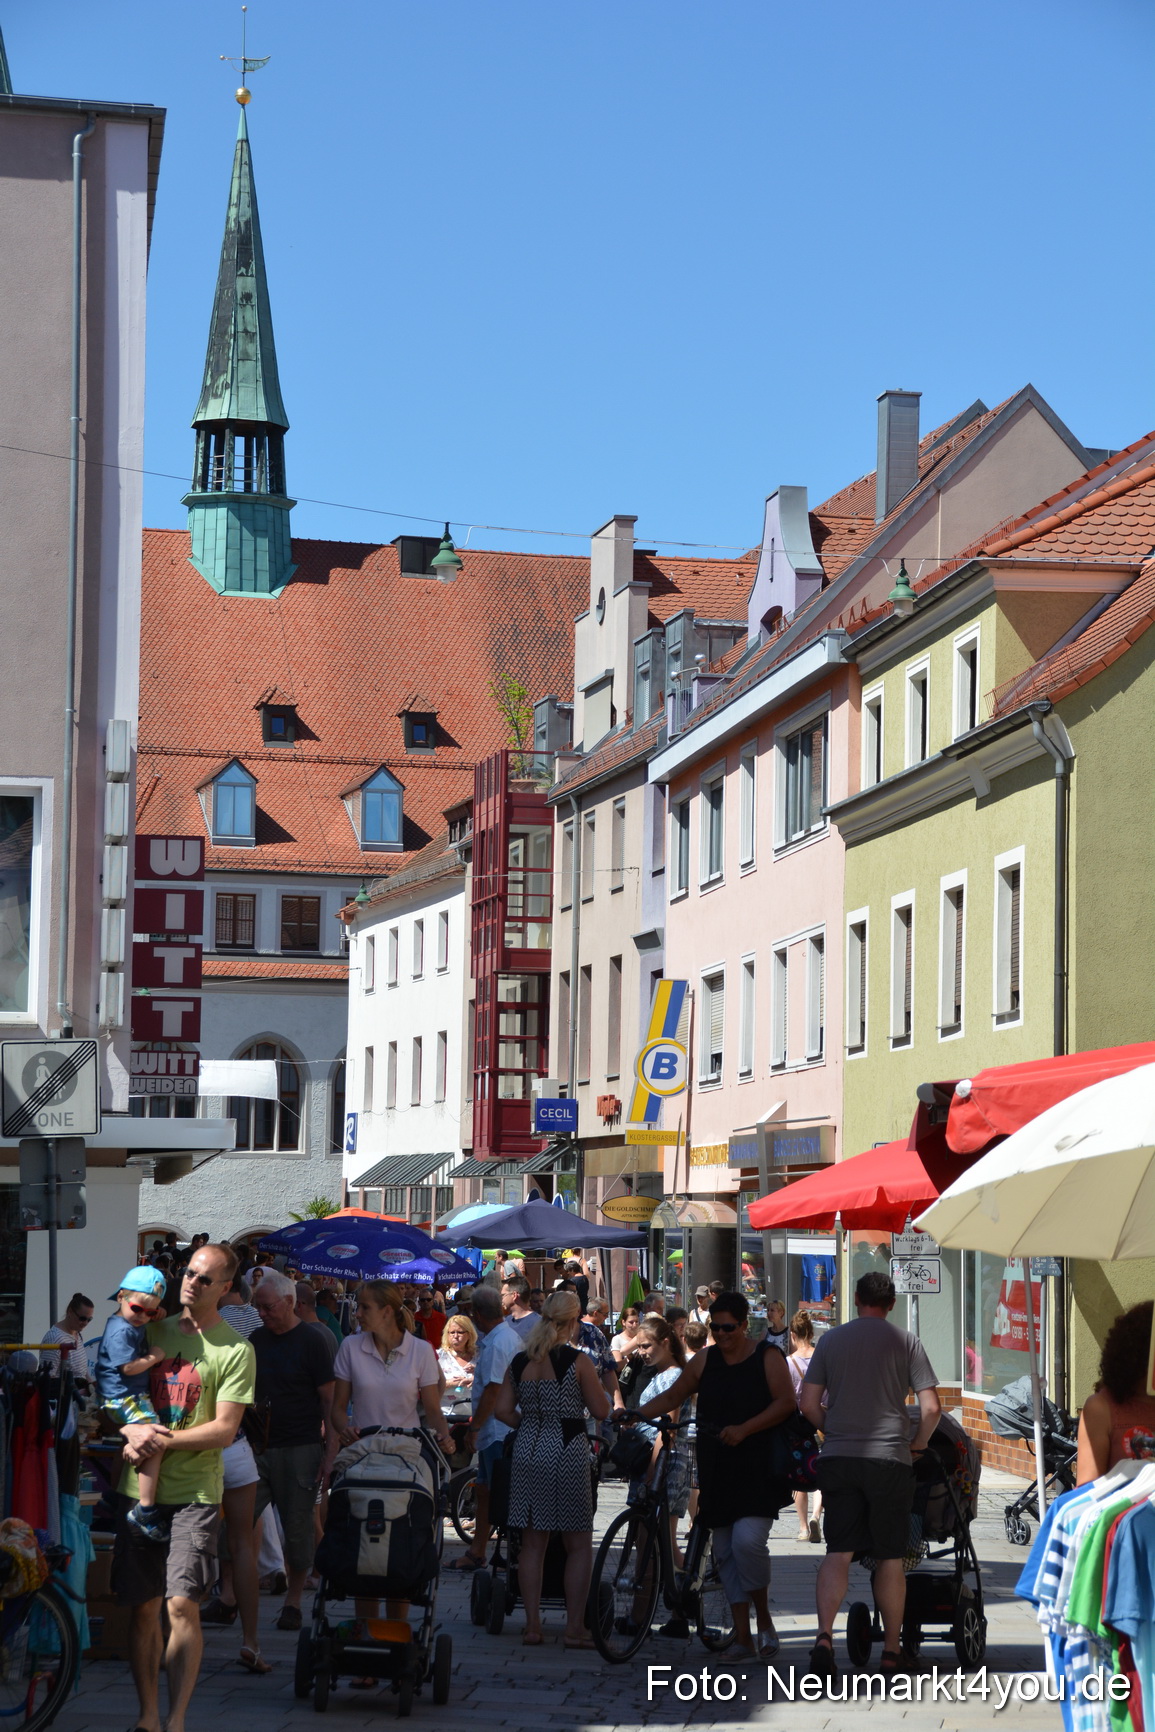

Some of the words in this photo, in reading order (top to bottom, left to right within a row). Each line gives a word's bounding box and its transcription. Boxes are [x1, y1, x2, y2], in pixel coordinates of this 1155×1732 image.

[149, 839, 201, 1038] WITT
[130, 1052, 197, 1074] WITT
[650, 1052, 679, 1080] B
[129, 1077, 198, 1094] WEIDEN
[539, 1108, 573, 1118] CECIL
[629, 1134, 677, 1142] KLOSTERGASSE
[301, 1263, 313, 1271] Der
[314, 1264, 332, 1273] Schatz
[333, 1267, 344, 1275] der
[376, 1272, 400, 1280] Schatz
[400, 1272, 412, 1280] der
[414, 1272, 433, 1281] Rhön.
[442, 1272, 455, 1280] Schatz
[908, 1282, 924, 1290] frei
